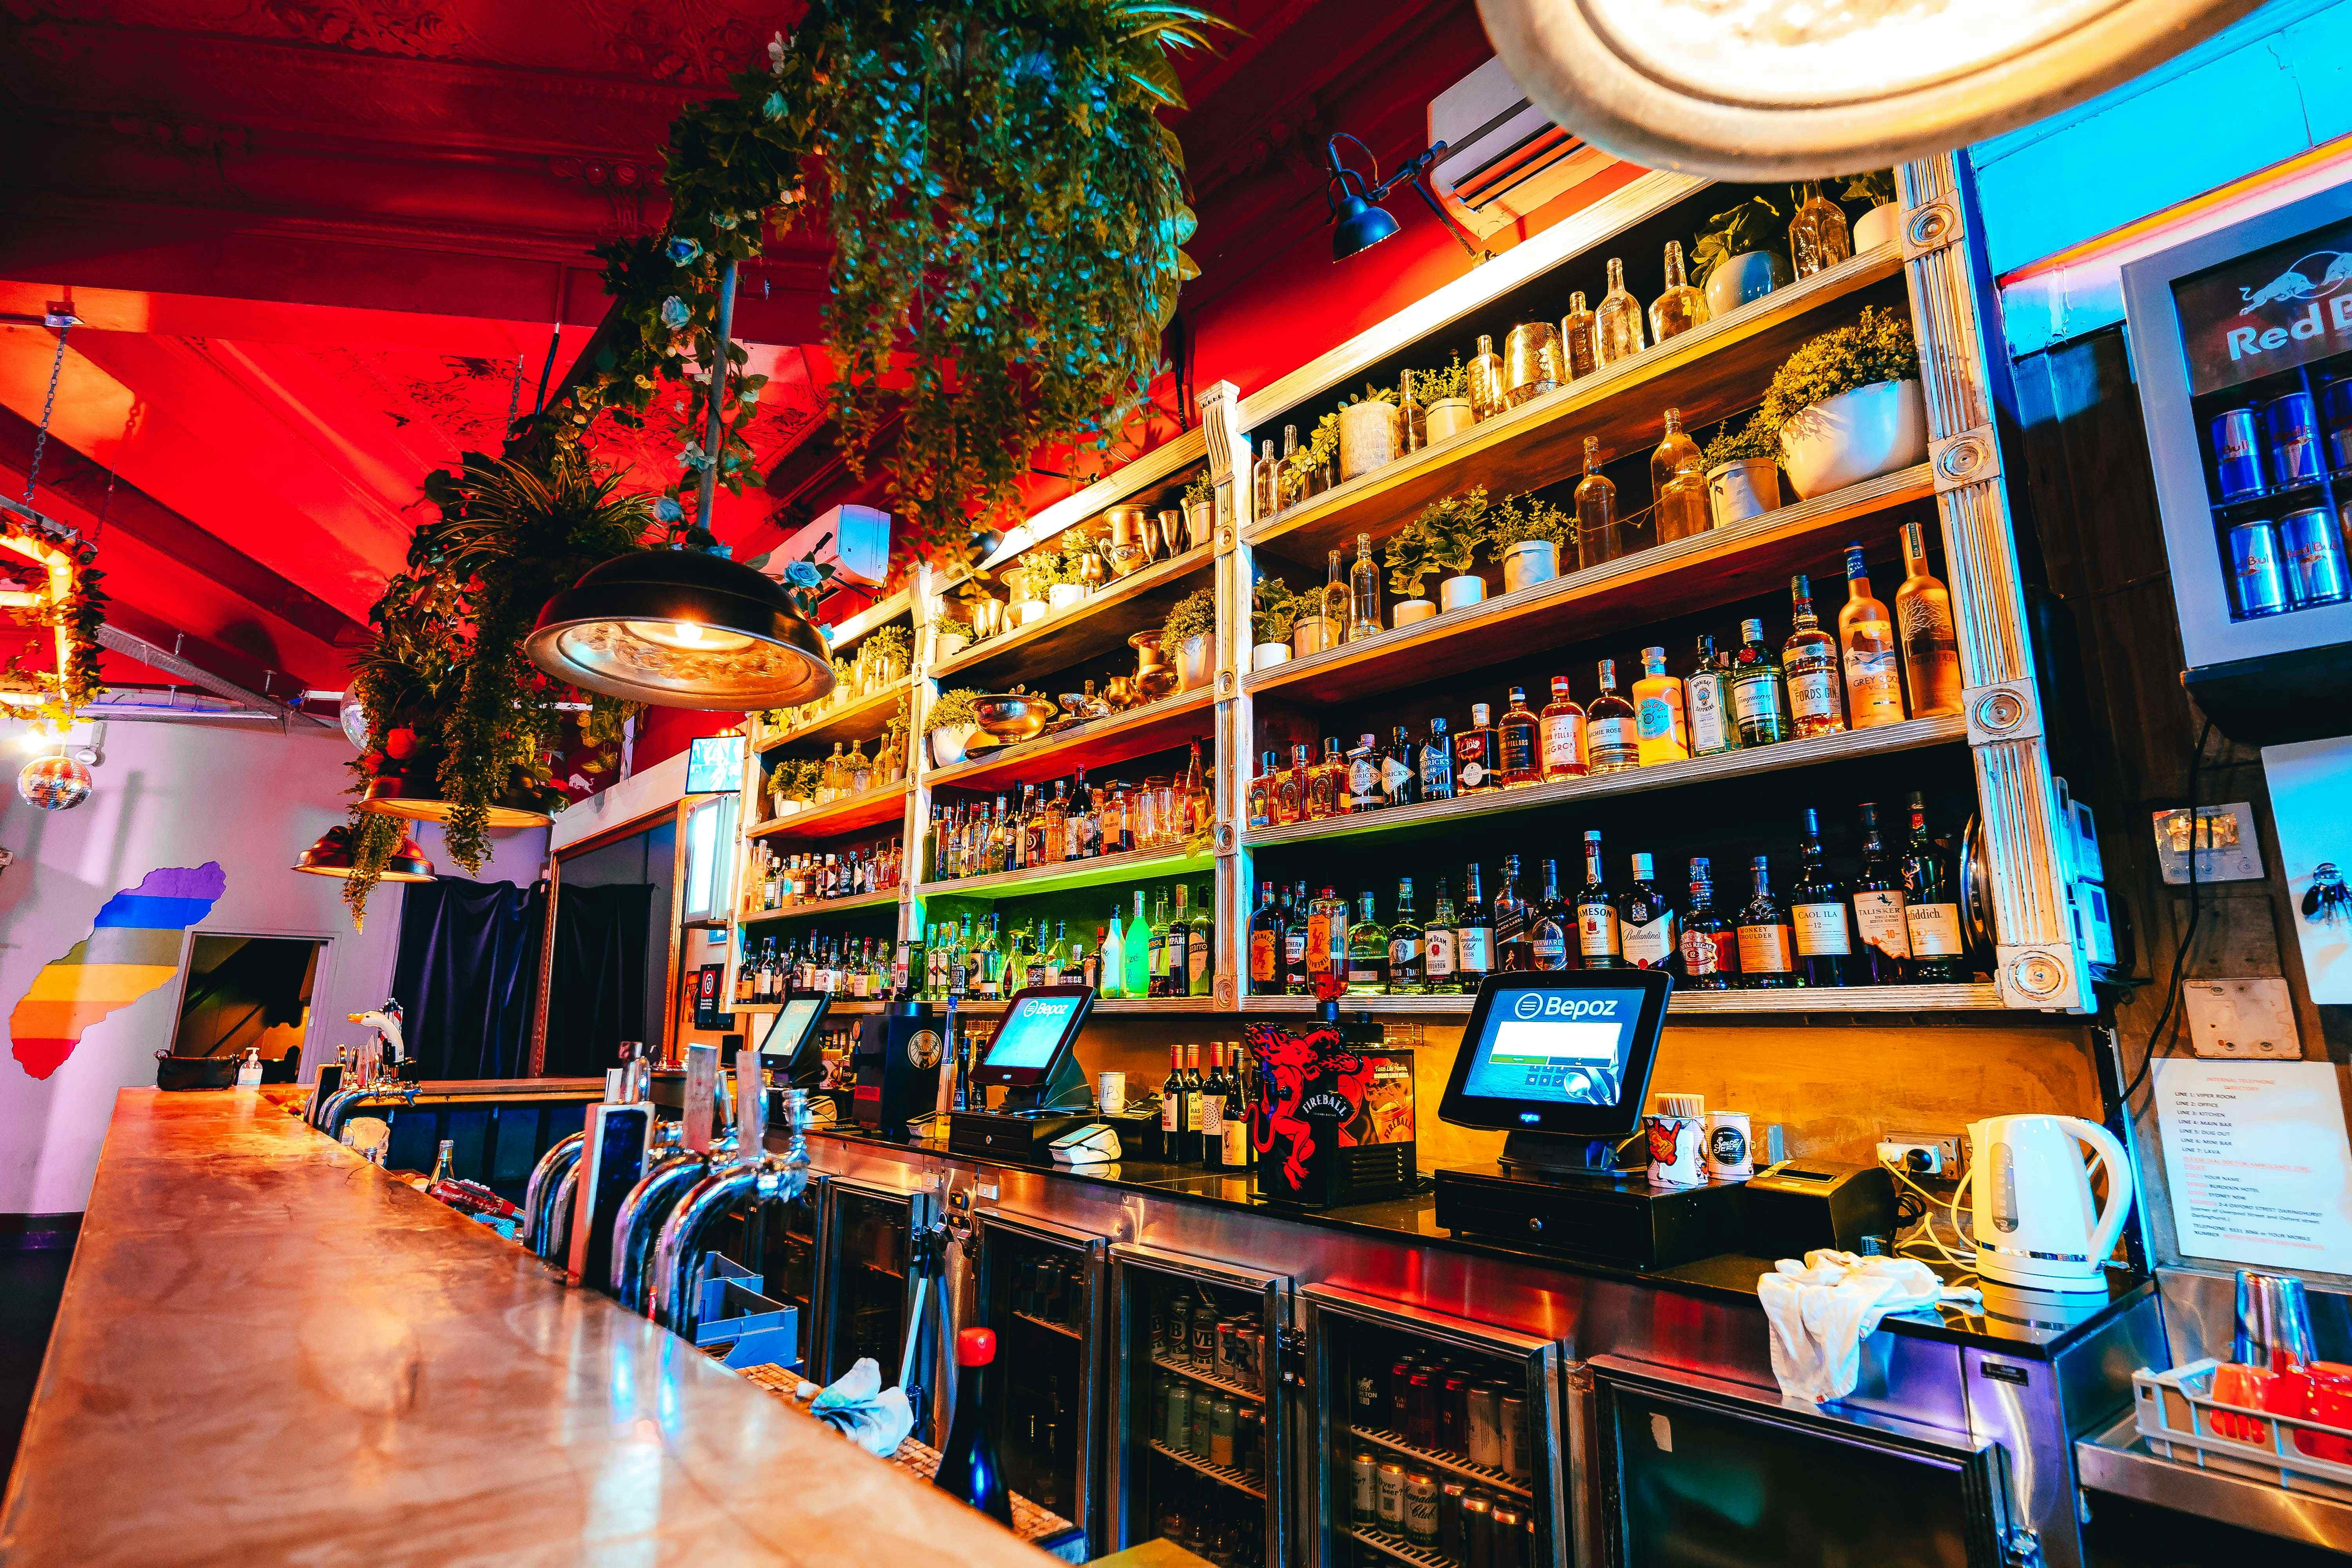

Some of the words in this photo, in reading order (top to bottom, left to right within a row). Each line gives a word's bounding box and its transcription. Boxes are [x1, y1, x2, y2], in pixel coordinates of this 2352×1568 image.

[2228, 305, 2325, 361] Red
[1693, 680, 1712, 689] BOMBAY
[1853, 676, 1875, 687] GREY
[1879, 675, 1898, 683] GOO
[1737, 693, 1772, 705] Tanqueray
[1795, 688, 1822, 703] FORDS
[1825, 686, 1837, 699] GIN
[1695, 702, 1715, 712] SAPPHIRE
[1589, 729, 1604, 738] ARCHIE
[1420, 759, 1449, 768] NDRICK'S
[1383, 770, 1408, 779] NDRICK'S
[1579, 907, 1612, 919] AMESON
[1858, 907, 1901, 916] TALISKER
[1908, 907, 1941, 920] fiddich
[1509, 918, 1523, 926] LABEL
[1252, 933, 1274, 944] FIREBALL
[1622, 928, 1661, 941] Ballantine's
[1886, 929, 1895, 939] 10
[1149, 939, 1163, 948] EROL
[1169, 936, 1185, 945] MPARI
[1433, 935, 1447, 946] BEAM
[1693, 942, 1713, 950] REGAL
[1189, 943, 1207, 952] zzarro
[1406, 968, 1420, 976] TRACE
[1036, 1002, 1069, 1017] Bepoz
[1544, 996, 1618, 1020] Bepoz
[1302, 1094, 1347, 1116] FIREBALL
[1384, 1117, 1412, 1139] FIREBALL
[1379, 1477, 1396, 1490] Over
[1381, 1485, 1402, 1495] beer?
[1405, 1485, 1437, 1503] Canadi
